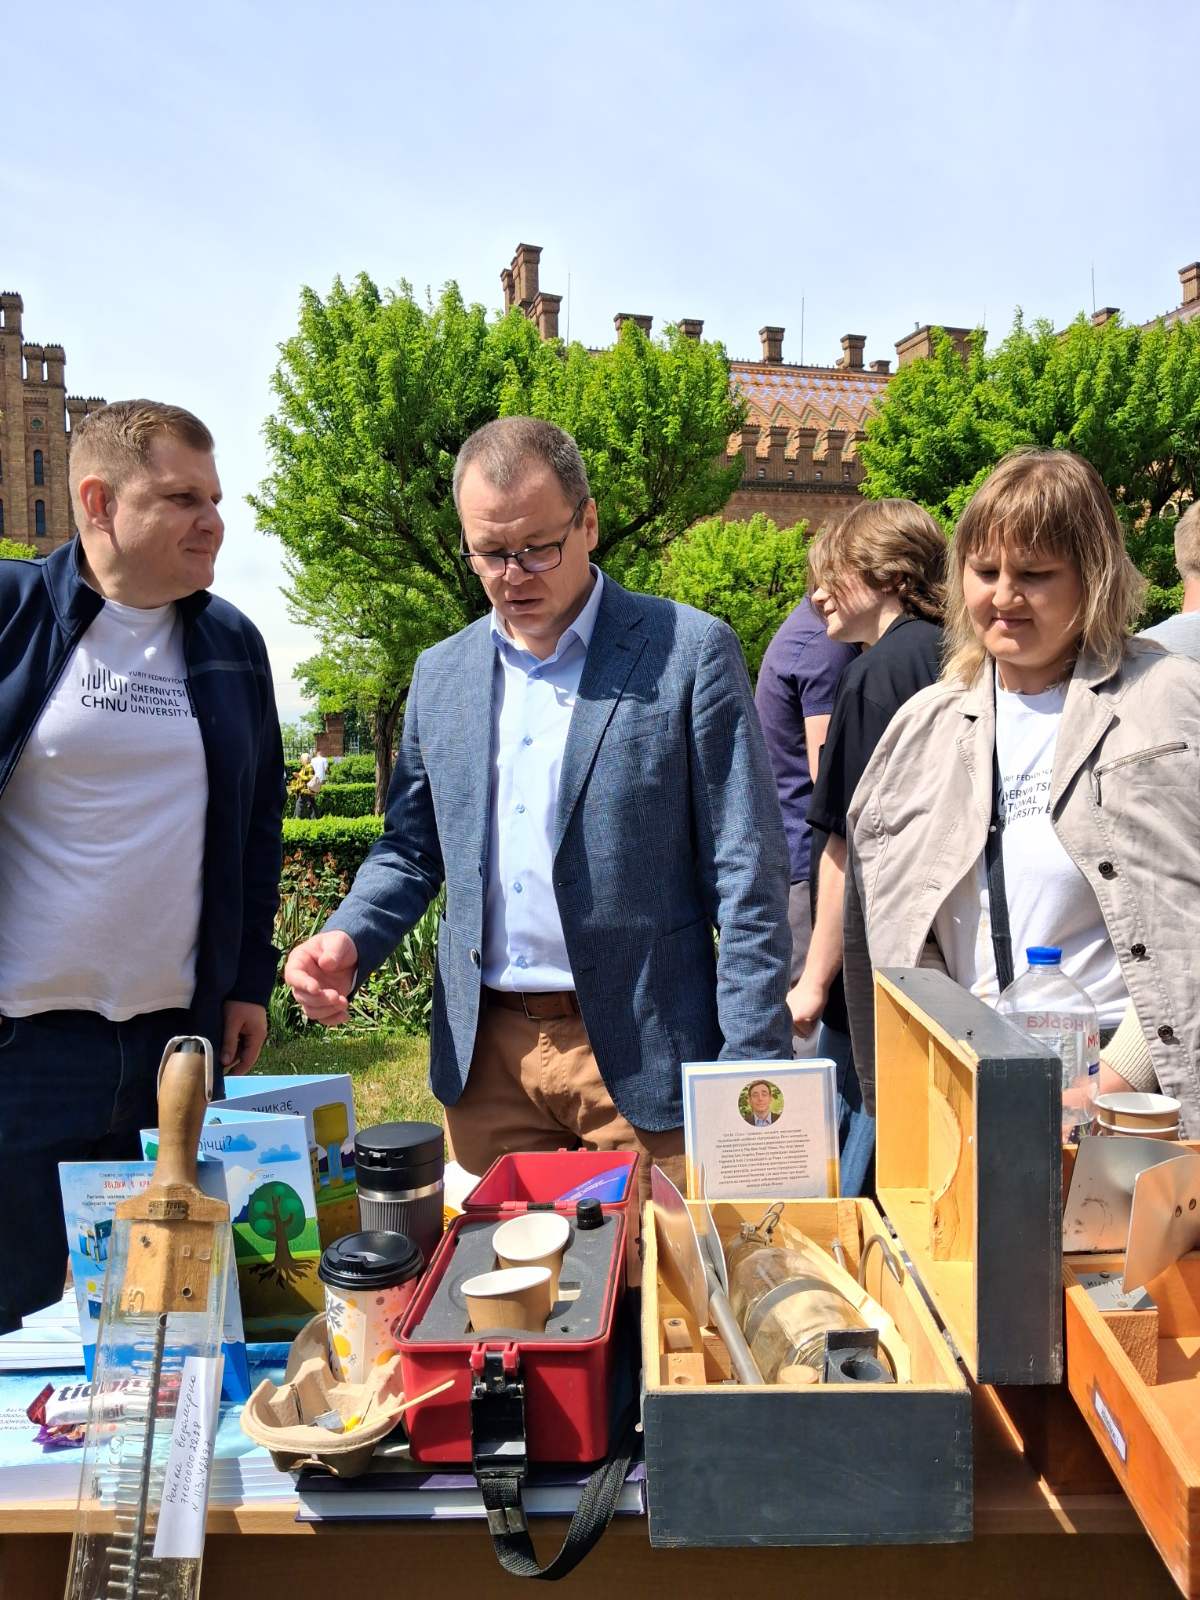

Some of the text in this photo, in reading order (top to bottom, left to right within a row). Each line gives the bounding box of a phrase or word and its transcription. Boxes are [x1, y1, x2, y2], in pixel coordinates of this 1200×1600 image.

[130, 682, 186, 698] CHERNIVTSI
[81, 694, 127, 713] CHNU
[130, 693, 181, 707] NATIONAL
[130, 704, 189, 718] UNIVERSITY
